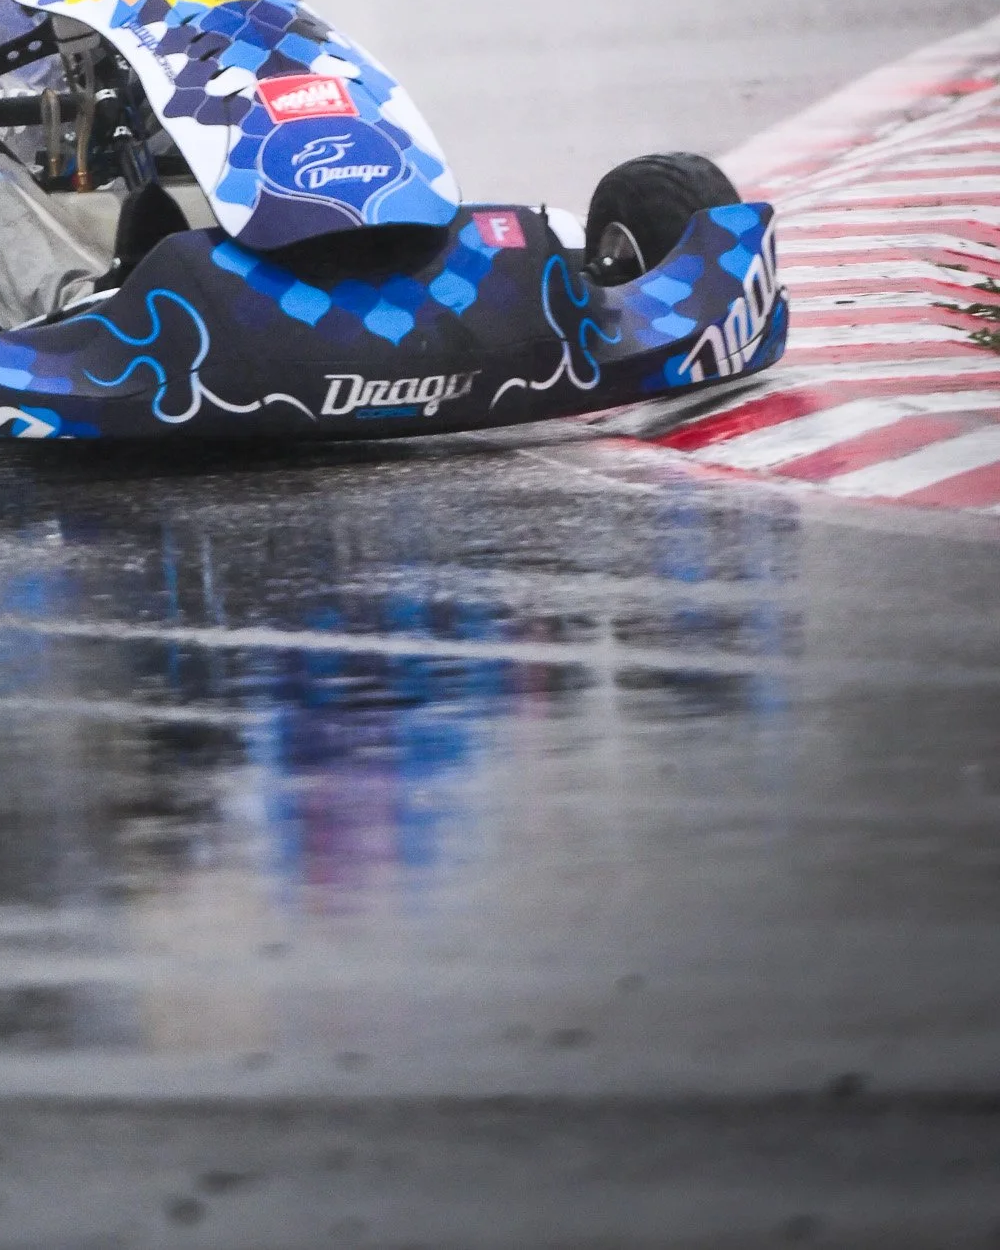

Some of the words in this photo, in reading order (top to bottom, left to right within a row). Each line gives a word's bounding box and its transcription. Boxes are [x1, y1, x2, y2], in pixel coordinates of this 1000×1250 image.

[306, 164, 393, 189] Drago
[488, 217, 510, 241] F
[320, 369, 483, 417] Drago
